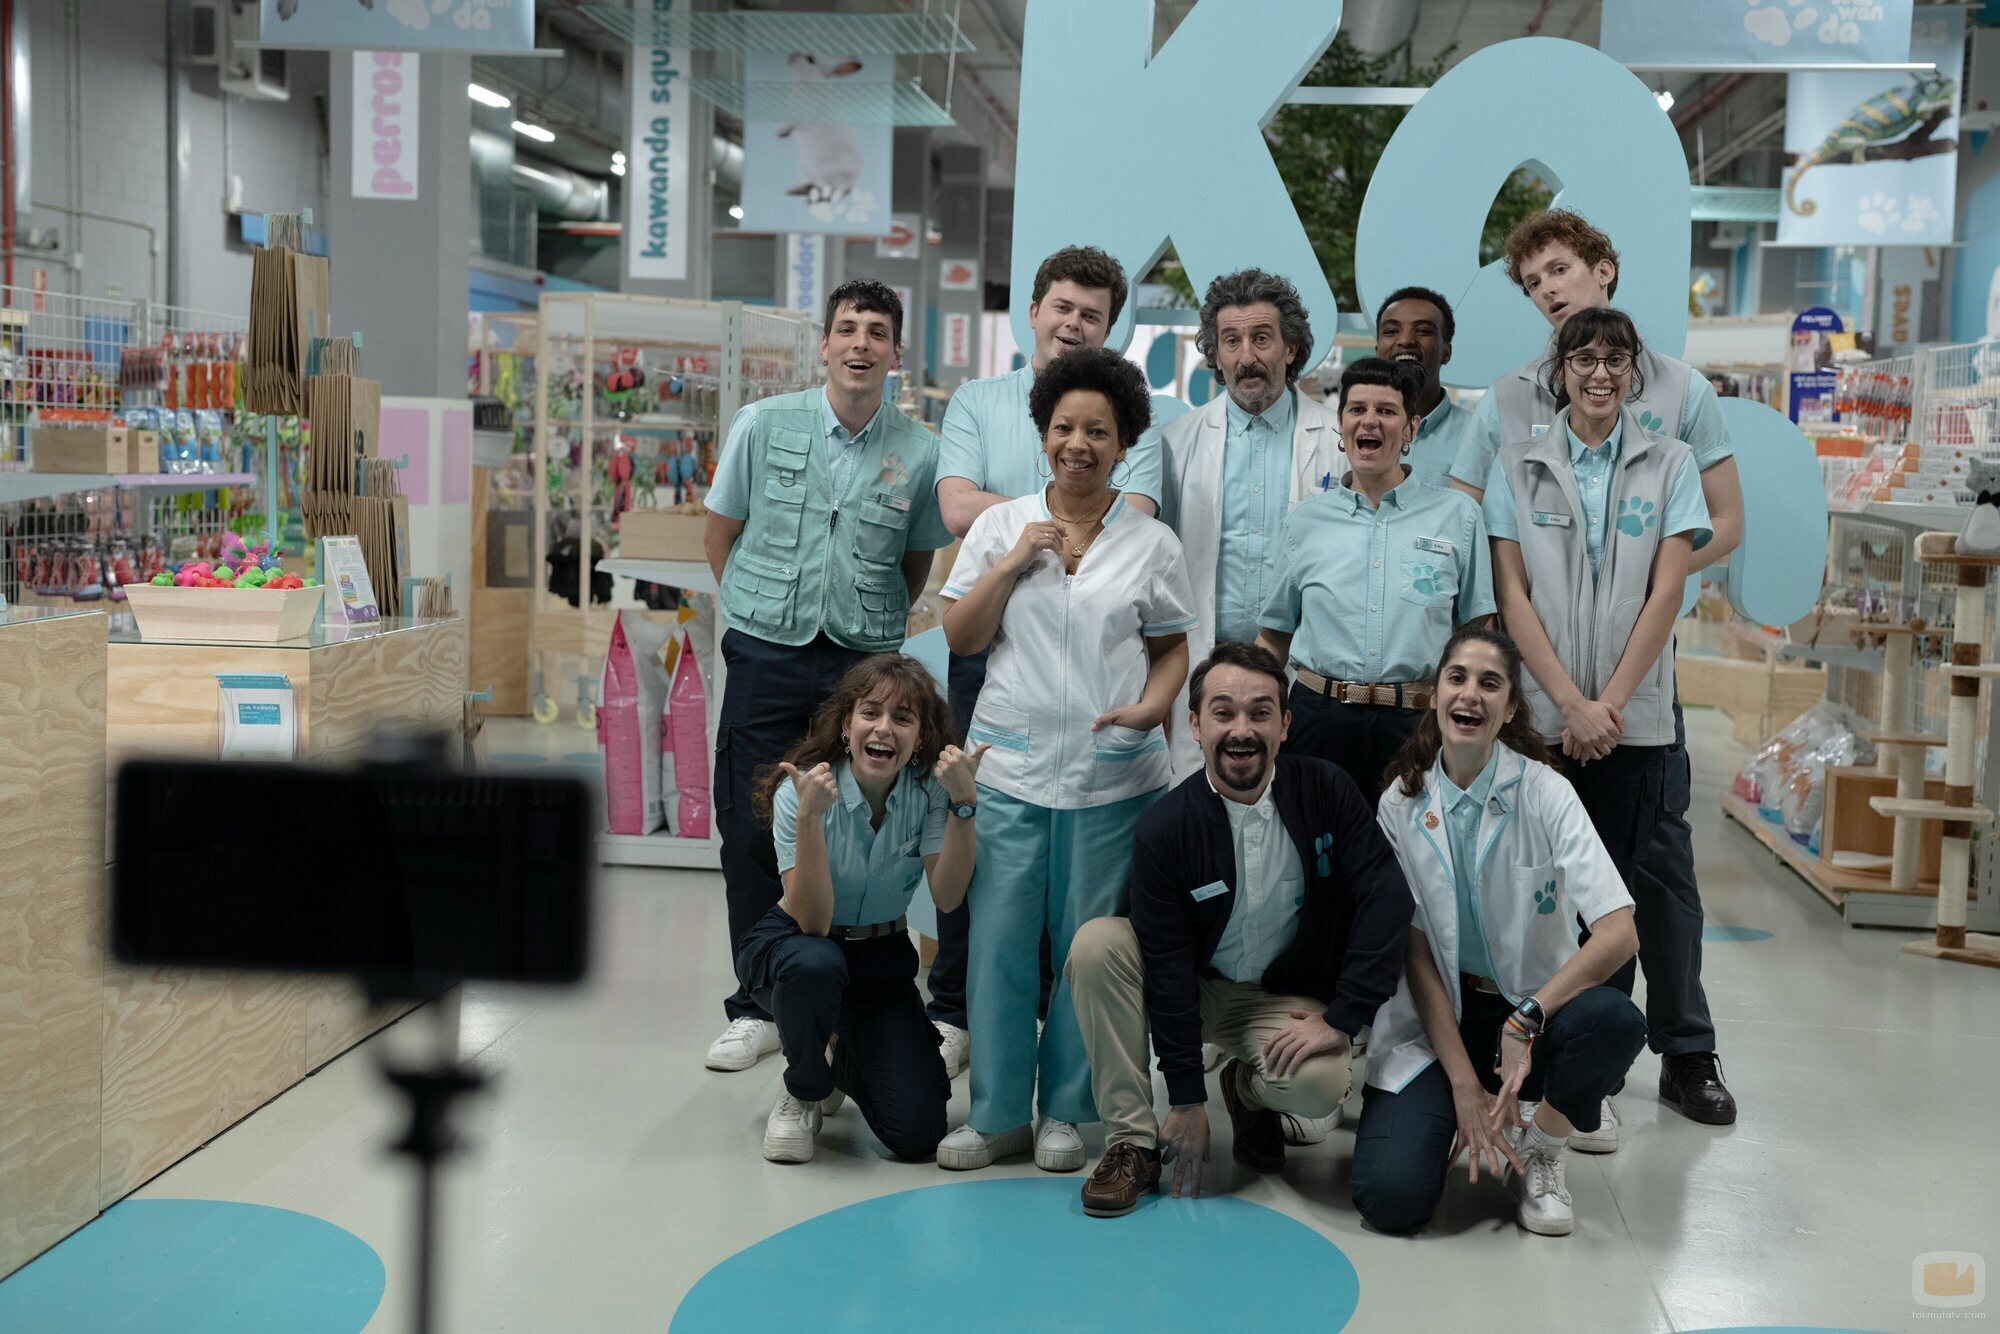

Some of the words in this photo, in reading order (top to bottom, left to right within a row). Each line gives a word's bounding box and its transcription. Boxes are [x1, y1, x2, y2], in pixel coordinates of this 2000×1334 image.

[1817, 12, 1860, 45] da
[1838, 5, 1883, 22] wan
[371, 50, 414, 194] perros
[641, 117, 669, 258] kawanda
